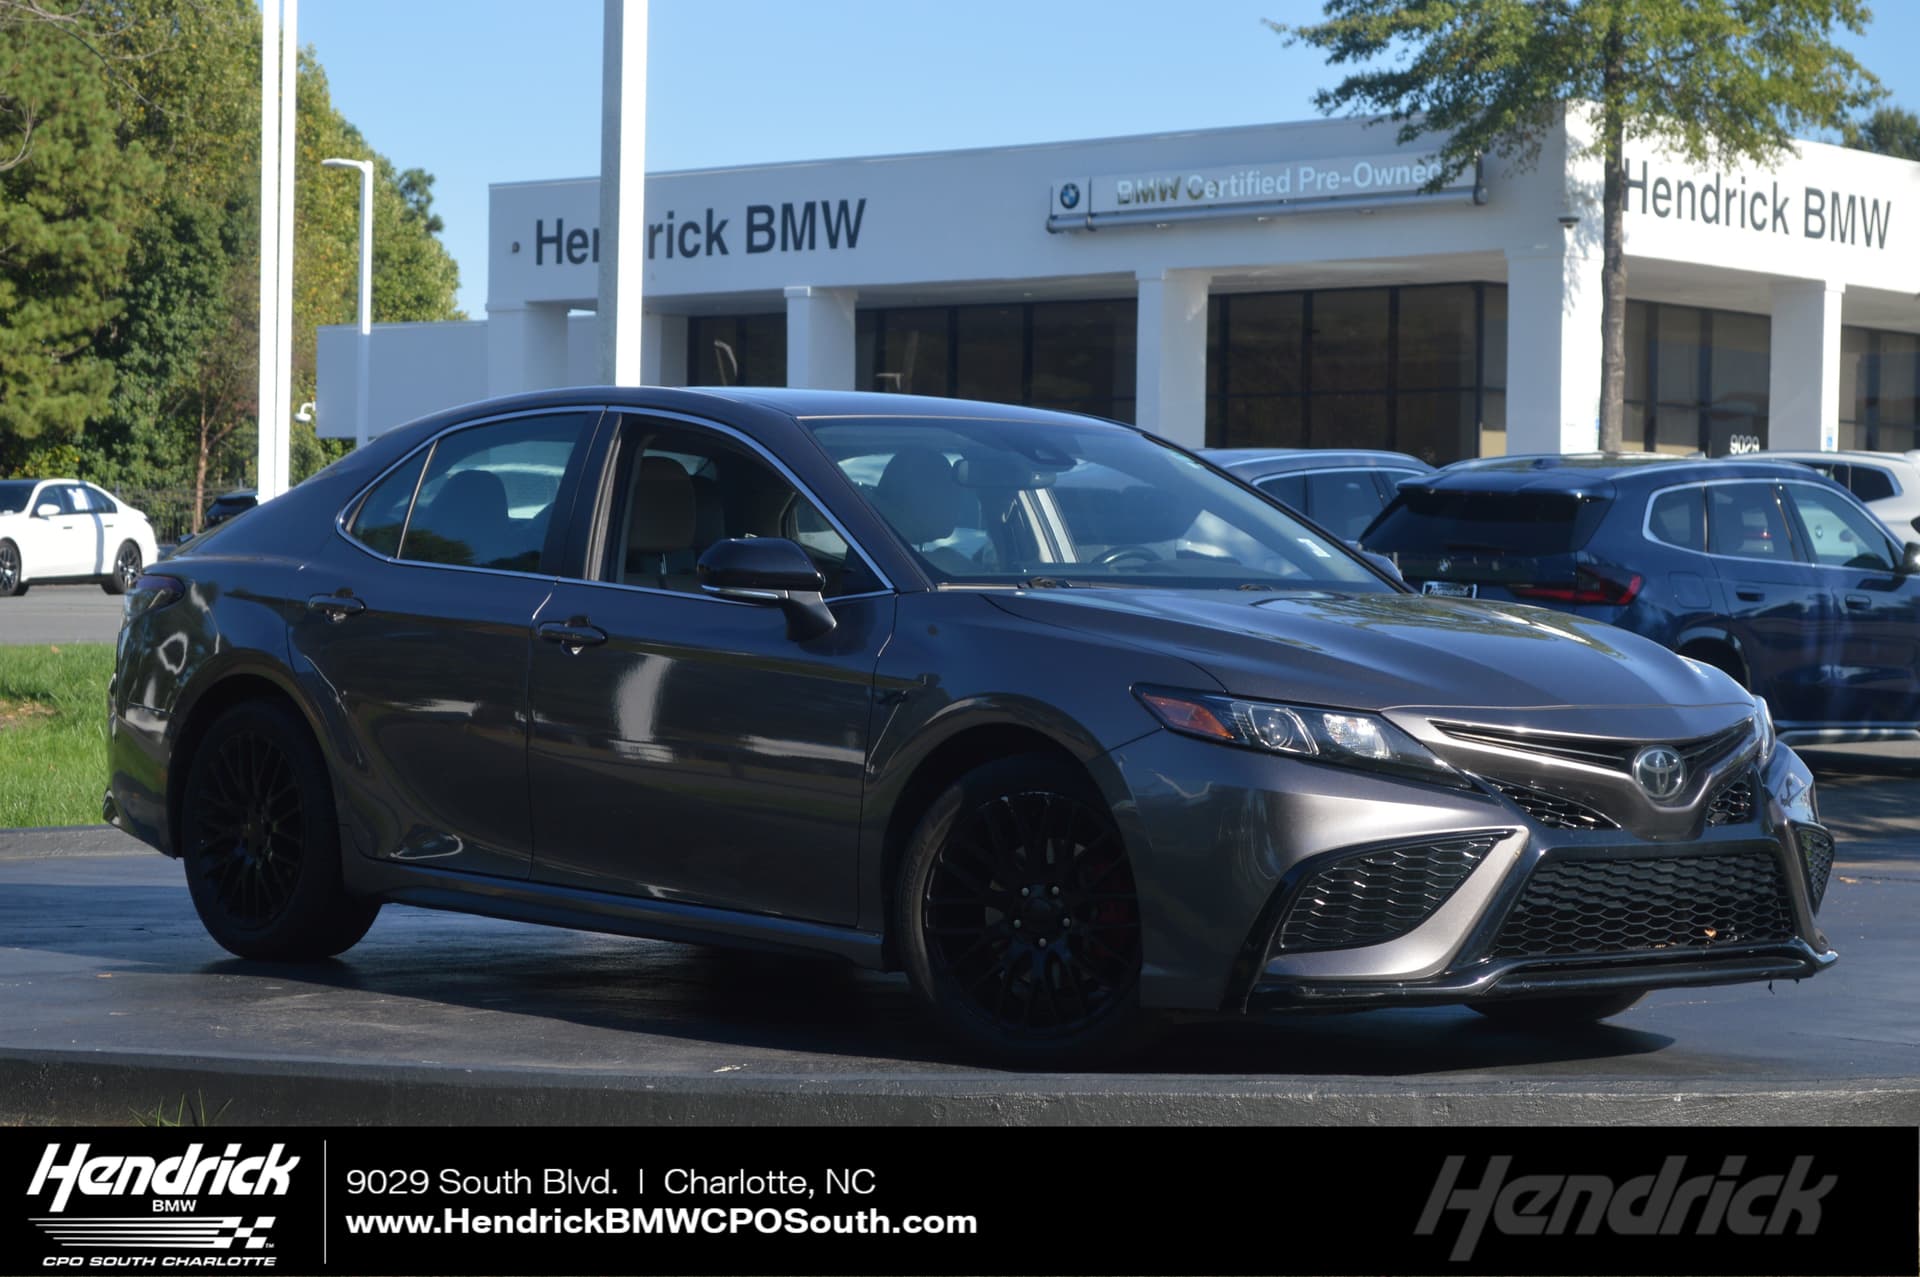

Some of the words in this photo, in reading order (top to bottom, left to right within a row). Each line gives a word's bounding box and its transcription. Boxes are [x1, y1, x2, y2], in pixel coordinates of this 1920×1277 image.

[1117, 176, 1181, 205] BMW
[1186, 167, 1291, 201] Certified
[1622, 157, 1790, 235] Hendrick
[1803, 186, 1891, 250] BMW
[534, 206, 730, 266] Herick
[745, 198, 867, 254] BMW
[1729, 434, 1760, 455] 9029
